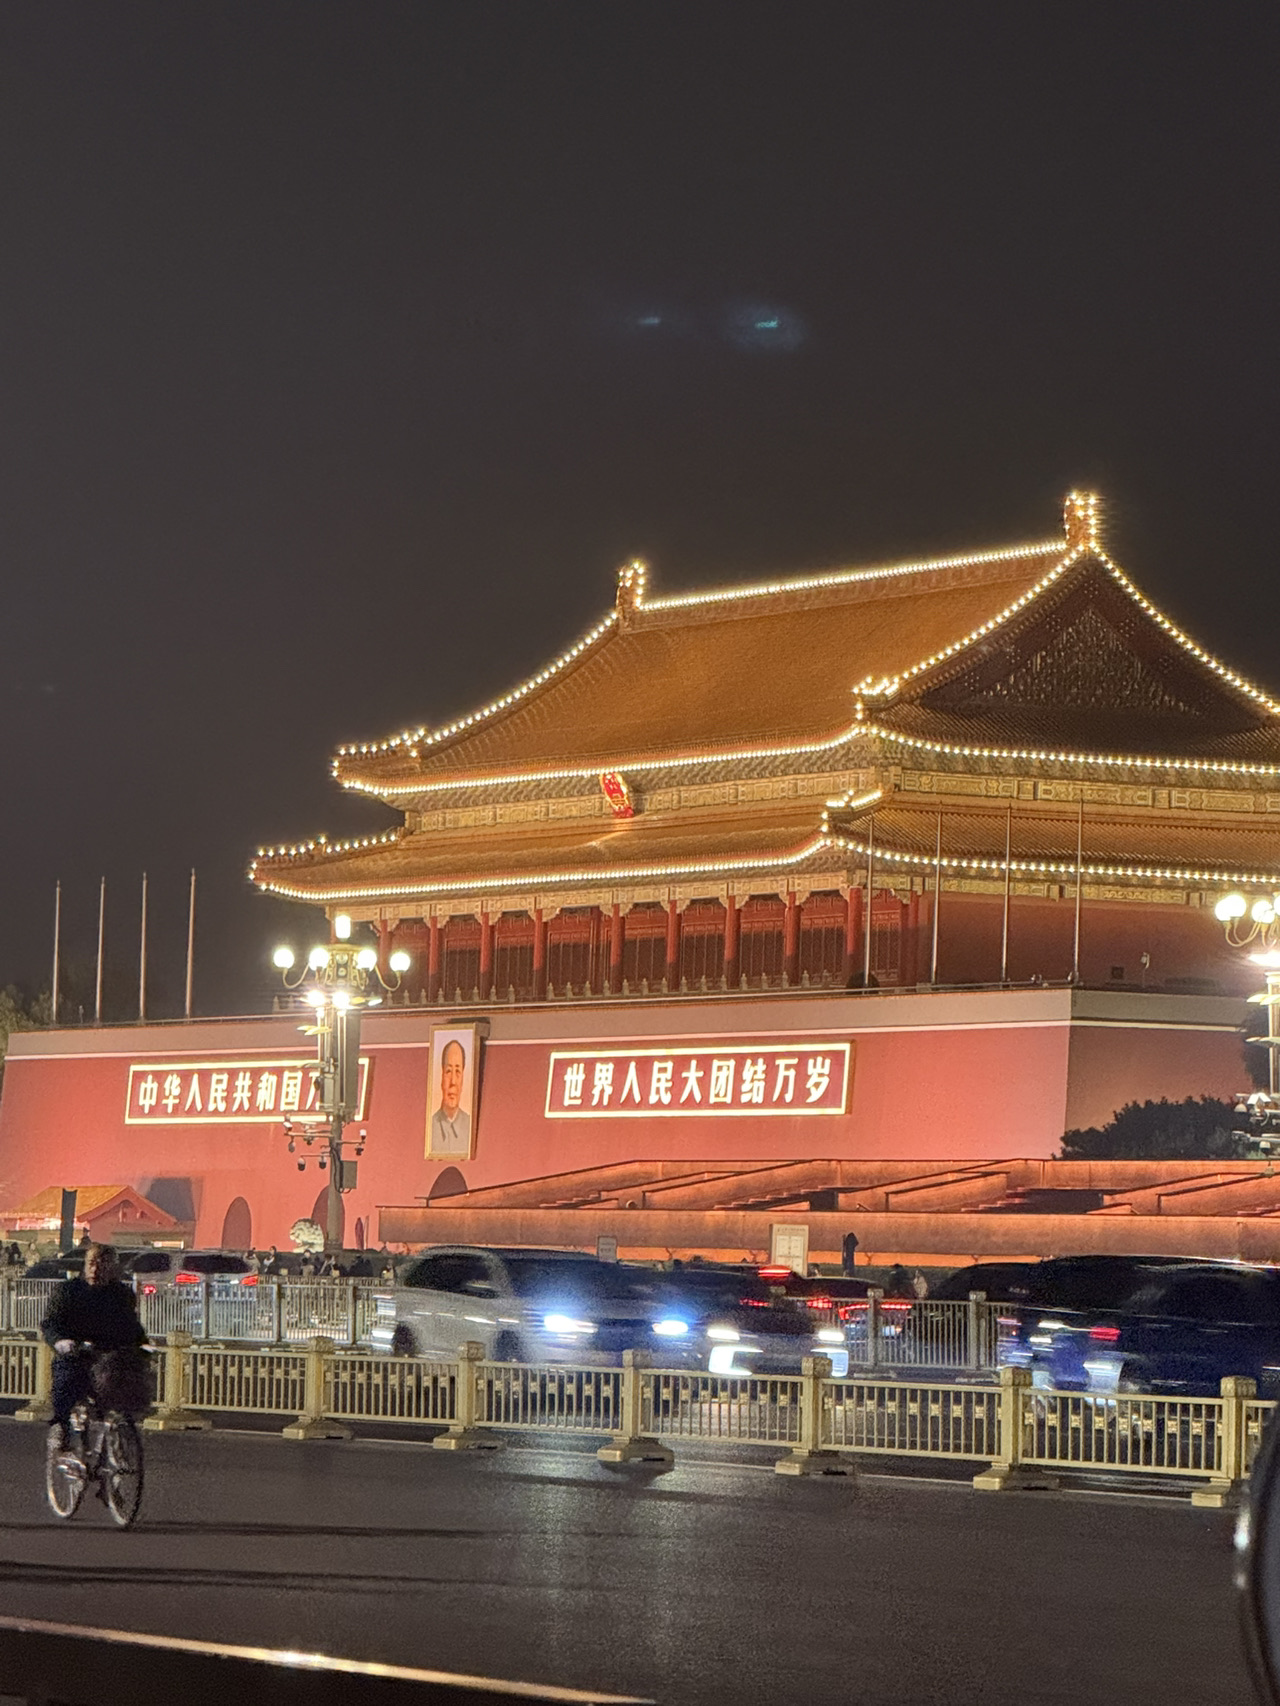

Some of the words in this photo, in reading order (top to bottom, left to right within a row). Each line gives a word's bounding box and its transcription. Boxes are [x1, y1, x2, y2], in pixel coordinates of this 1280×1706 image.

[138, 1070, 320, 1114] 中华人民共和国
[563, 1056, 832, 1107] 世界人民大团结万岁
